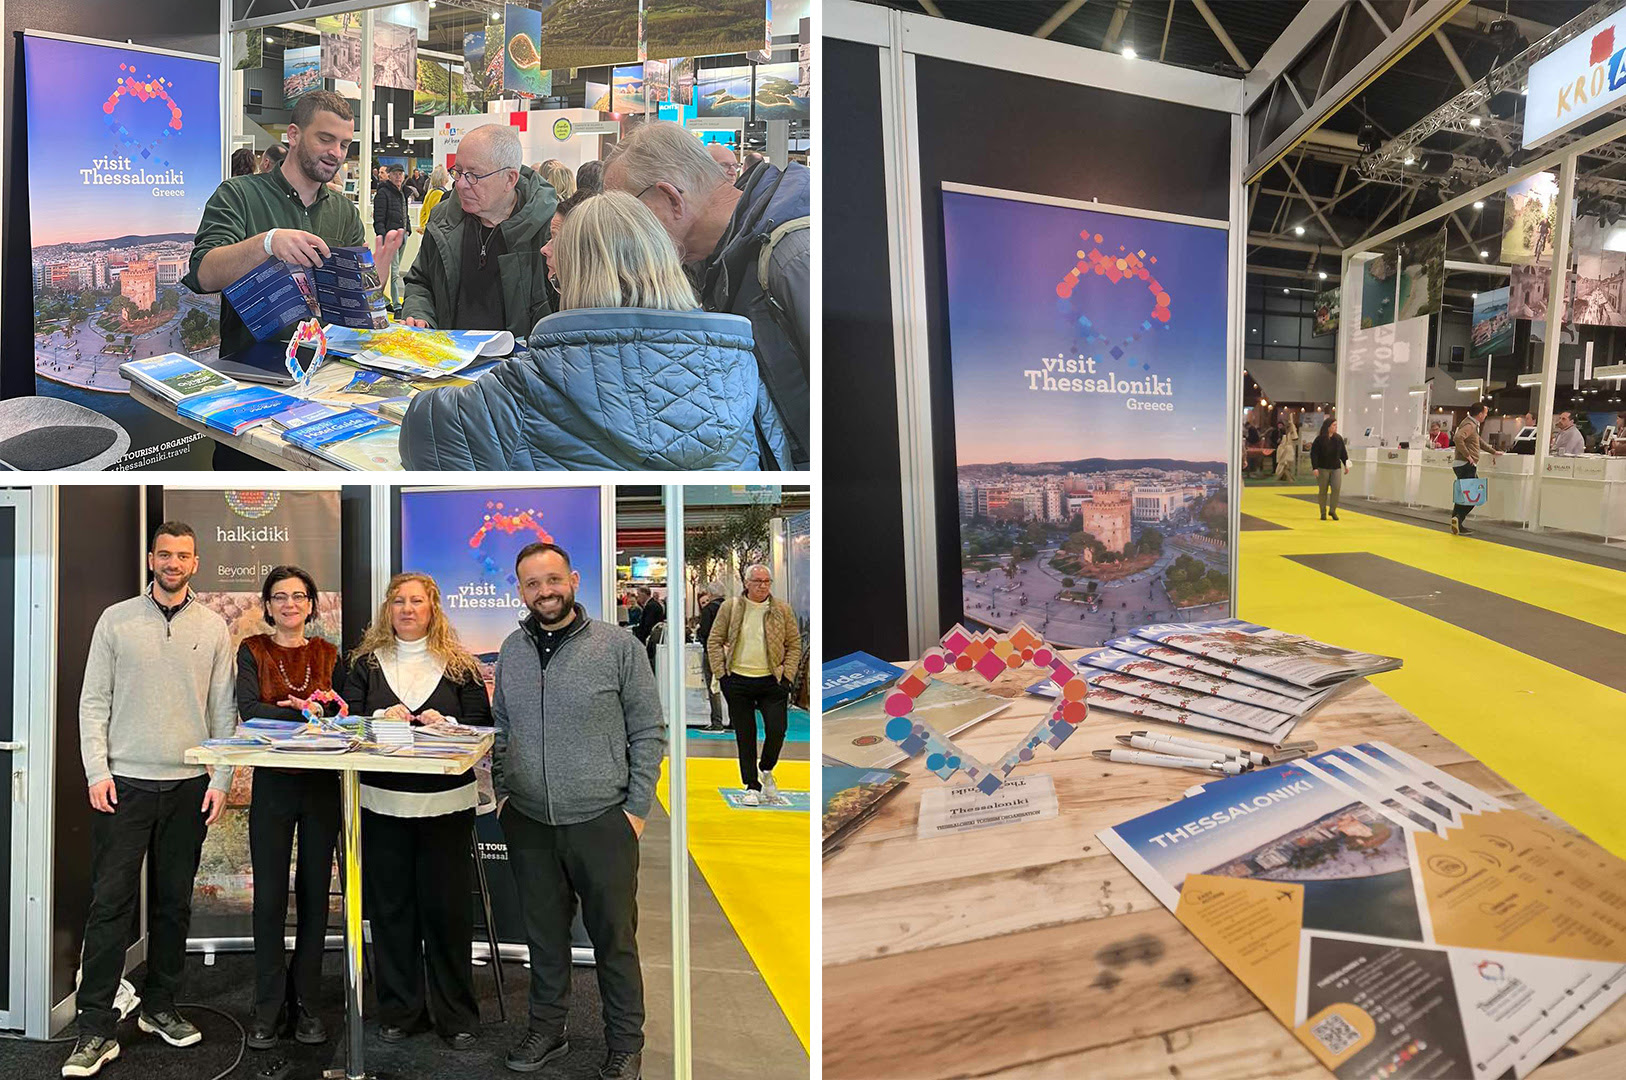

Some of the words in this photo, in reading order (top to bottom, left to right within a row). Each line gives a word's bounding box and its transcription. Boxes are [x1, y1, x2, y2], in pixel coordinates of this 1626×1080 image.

[93, 155, 131, 171] visit
[80, 168, 185, 185] Thessaloniki
[152, 187, 185, 197] Greece
[1042, 353, 1096, 374] visit
[1024, 369, 1173, 396] Thessaloniki
[1126, 398, 1174, 412] Greece
[124, 445, 160, 463] TOURISM
[217, 526, 289, 542] halkidiki
[218, 565, 256, 578] Beyond
[459, 582, 496, 596] visit
[447, 594, 527, 608] Thessalo
[822, 672, 864, 690] uide
[949, 798, 1029, 815] Thessaloniki
[1149, 780, 1314, 849] THESSALONIKI
